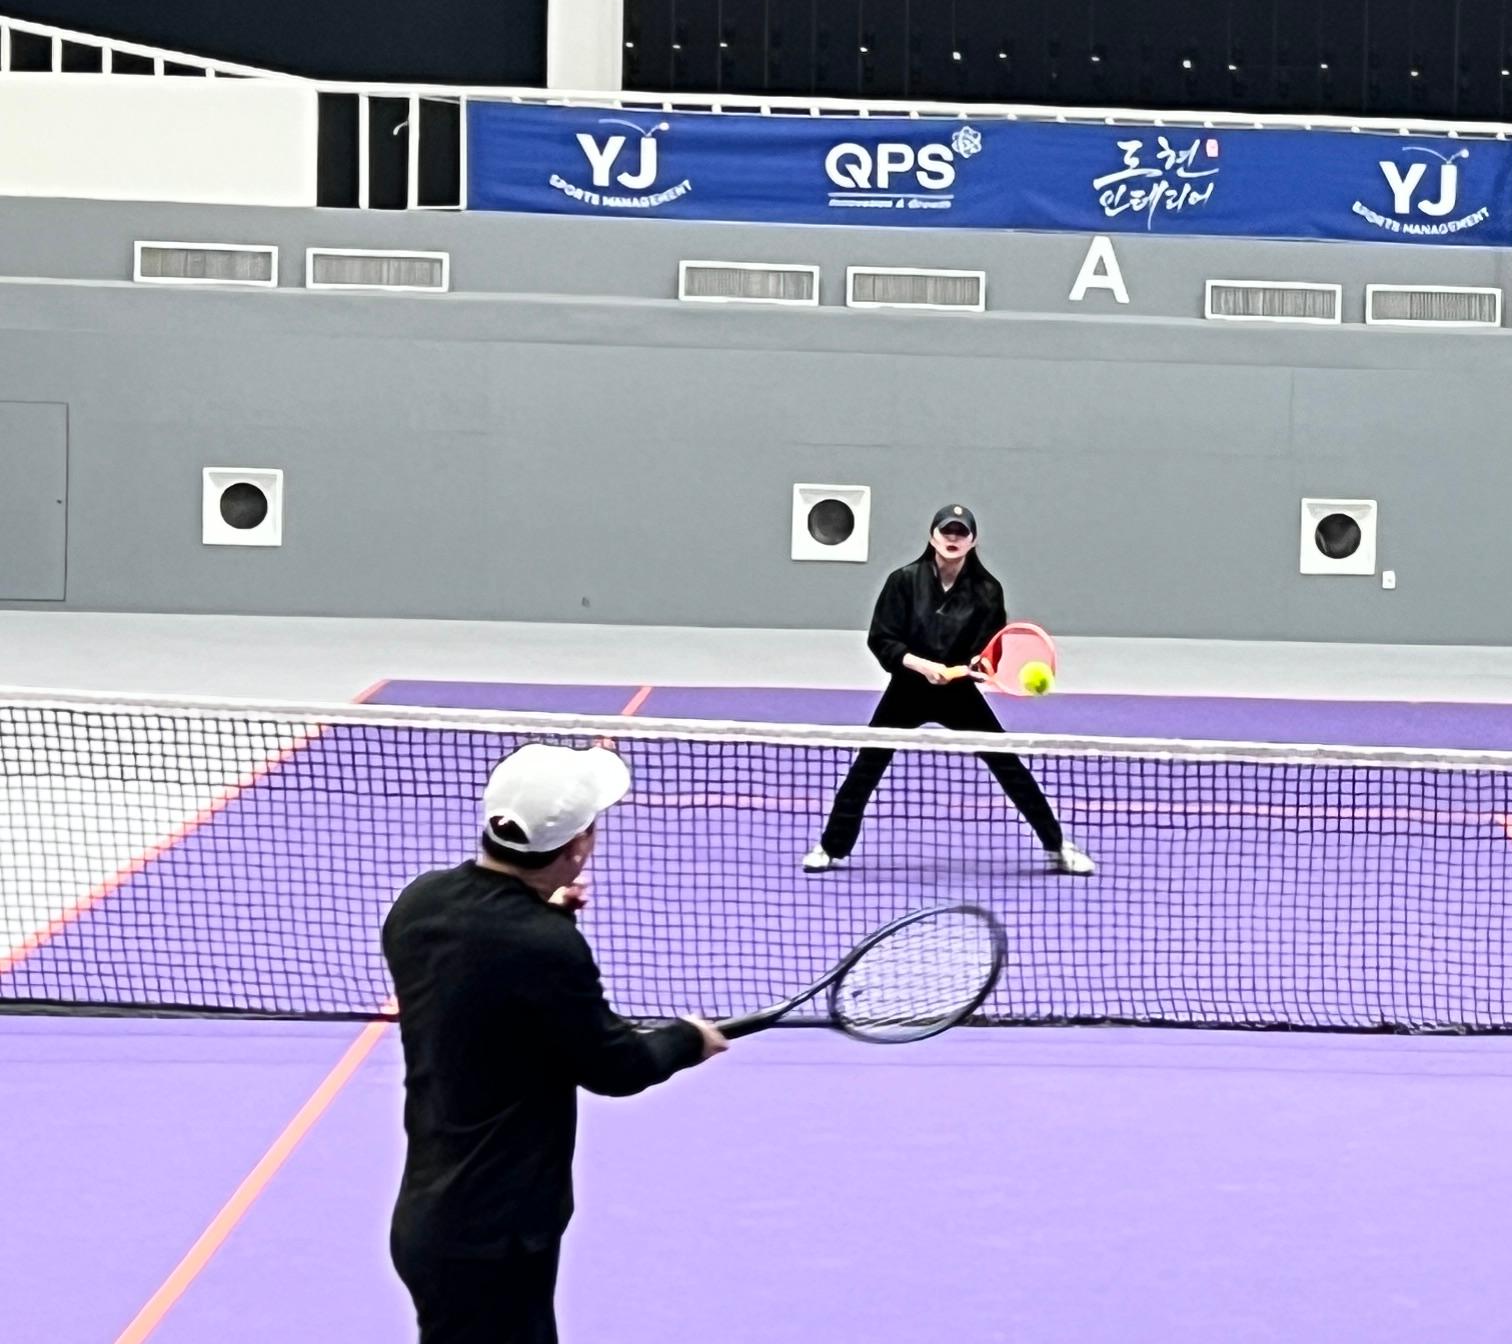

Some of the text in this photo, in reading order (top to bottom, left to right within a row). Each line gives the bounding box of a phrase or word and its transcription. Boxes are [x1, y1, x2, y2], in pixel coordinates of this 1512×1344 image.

[575, 133, 658, 189] YJ
[825, 143, 955, 189] QPS
[602, 179, 692, 208] MANAGEMENT
[1099, 180, 1214, 230] 인테리어
[1379, 160, 1458, 216] YJ
[1402, 206, 1490, 235] MANAGEMENT
[1068, 235, 1130, 304] A
